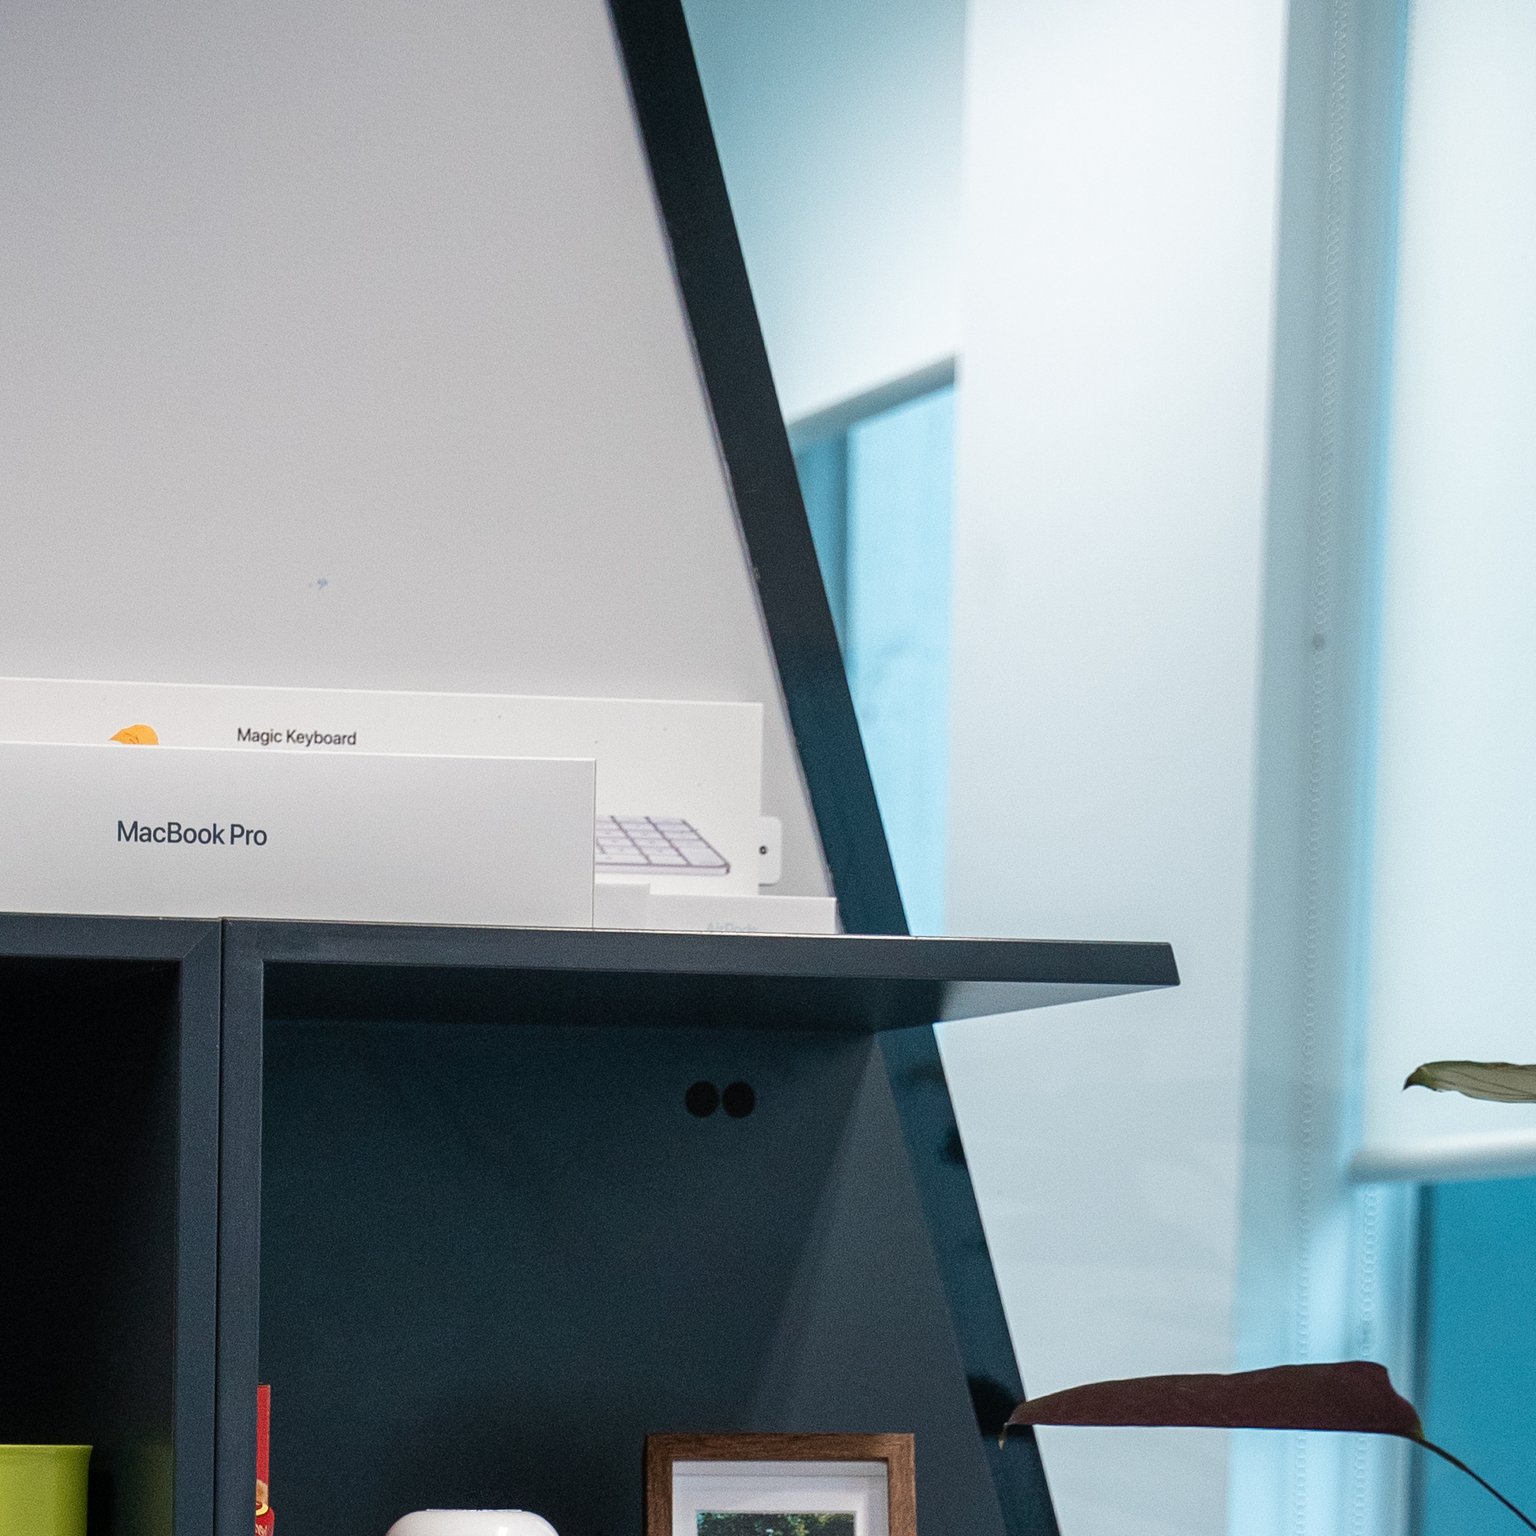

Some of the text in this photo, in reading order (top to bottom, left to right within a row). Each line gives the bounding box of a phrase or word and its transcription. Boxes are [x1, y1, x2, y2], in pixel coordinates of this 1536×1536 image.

[237, 728, 356, 747] Magic Keyboard
[117, 820, 267, 846] MacBook Pro
